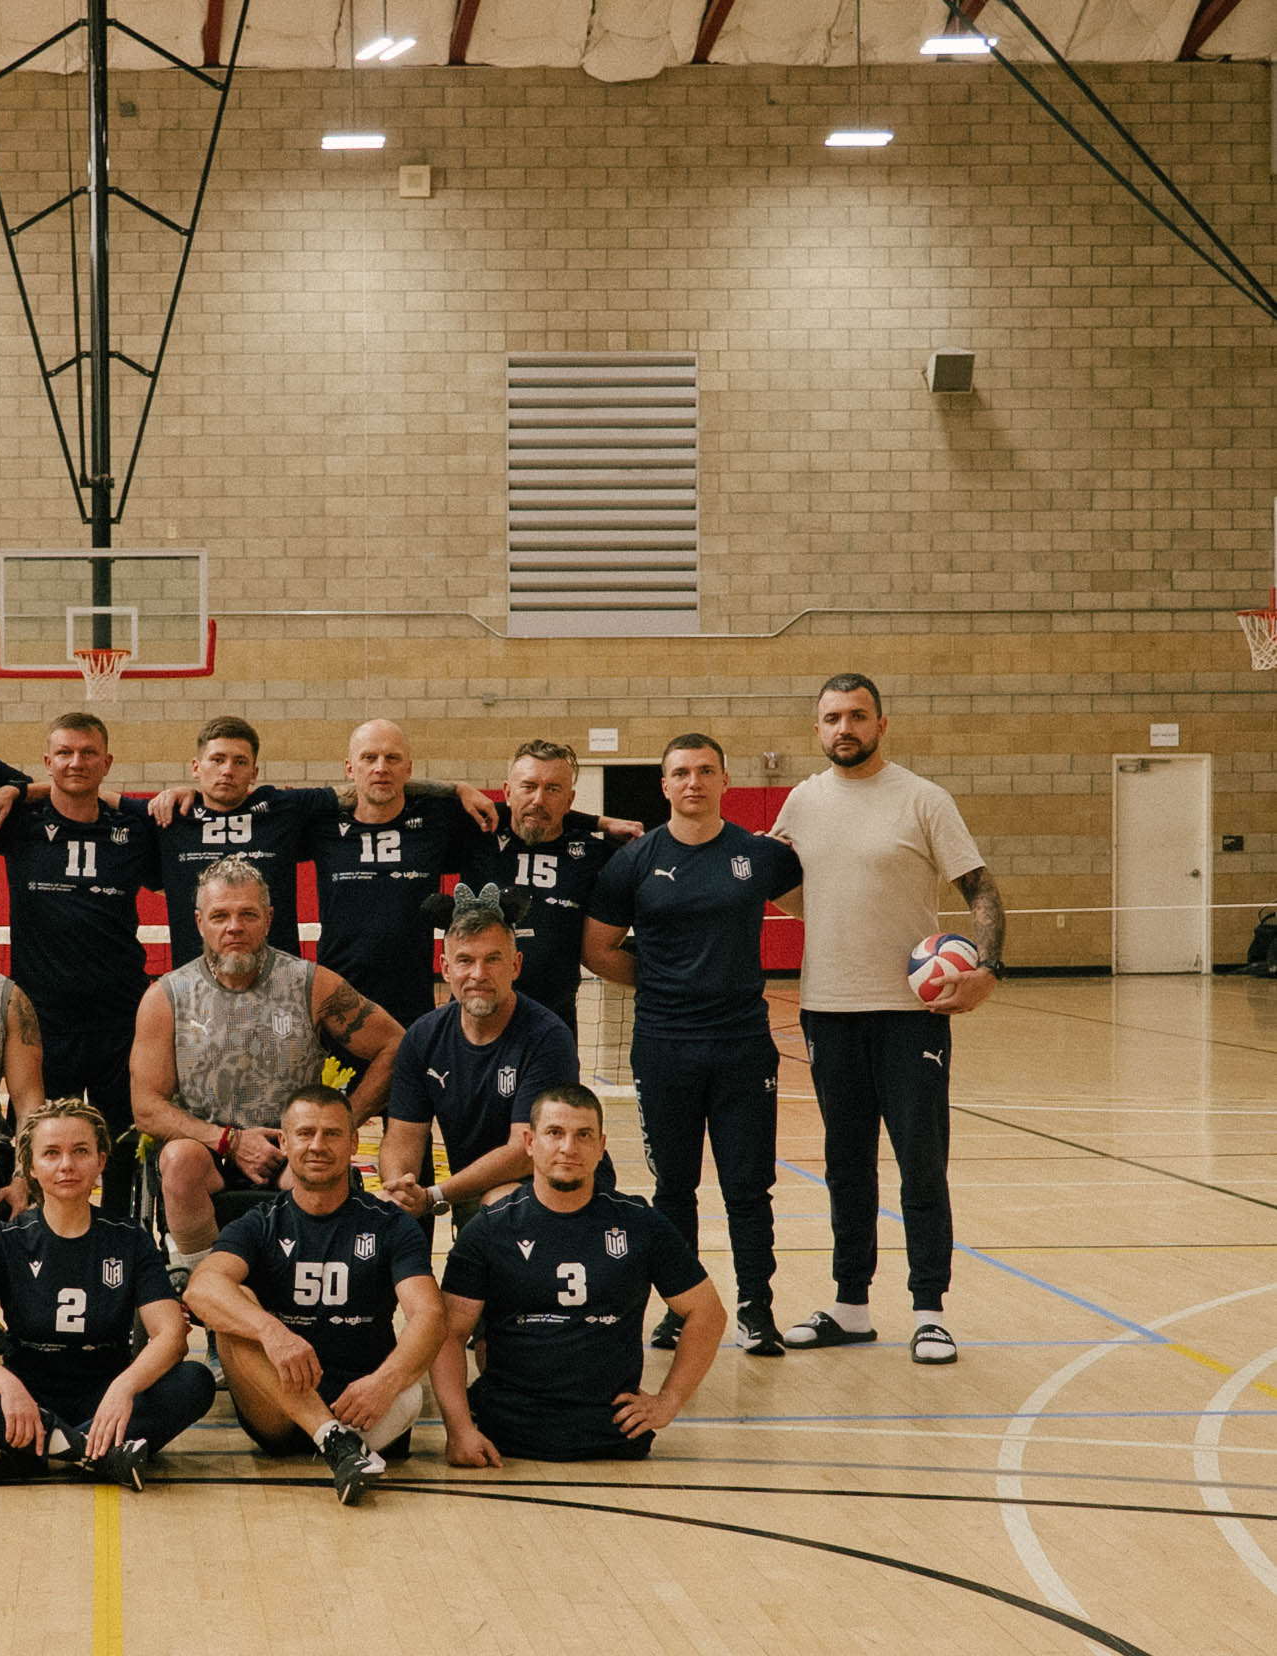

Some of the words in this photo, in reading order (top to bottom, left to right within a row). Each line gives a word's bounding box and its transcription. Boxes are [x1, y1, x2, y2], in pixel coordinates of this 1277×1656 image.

[202, 814, 252, 844] 29
[360, 830, 401, 863] 12
[65, 841, 98, 878] 11
[515, 854, 558, 888] 15
[293, 1262, 350, 1306] 50
[556, 1262, 587, 1306] 3
[55, 1288, 88, 1334] 2
